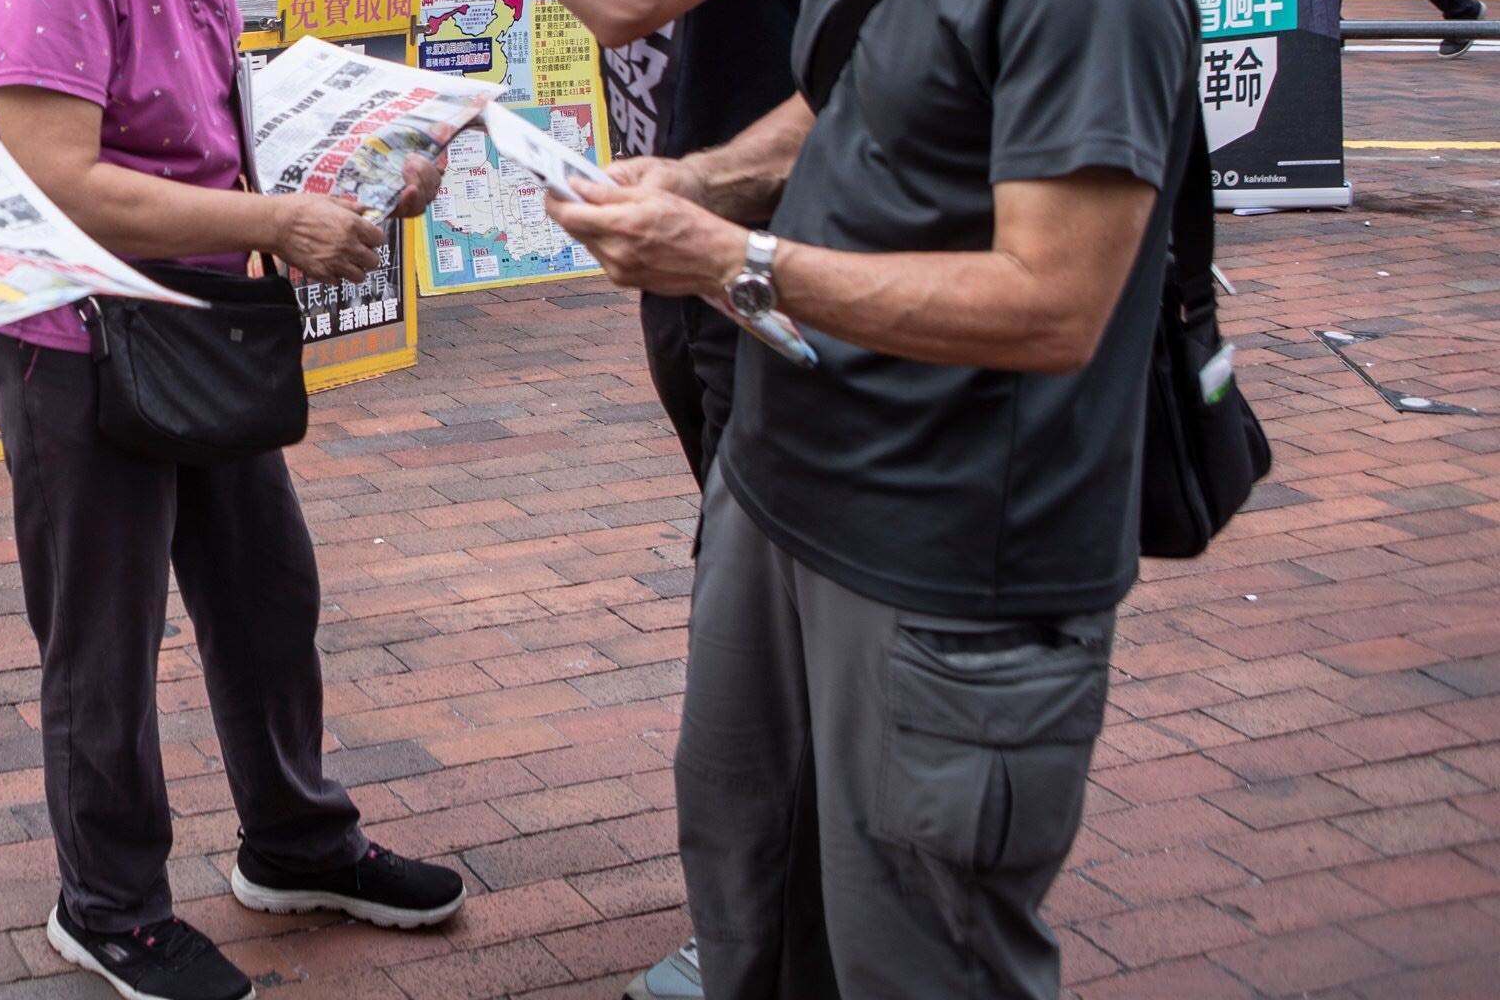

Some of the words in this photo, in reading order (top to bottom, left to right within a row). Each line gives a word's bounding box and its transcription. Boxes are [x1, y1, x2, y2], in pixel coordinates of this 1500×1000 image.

[1204, 46, 1263, 111] 革命
[469, 167, 487, 176] 1956
[436, 239, 454, 247] 1963
[472, 248, 489, 257] 1961
